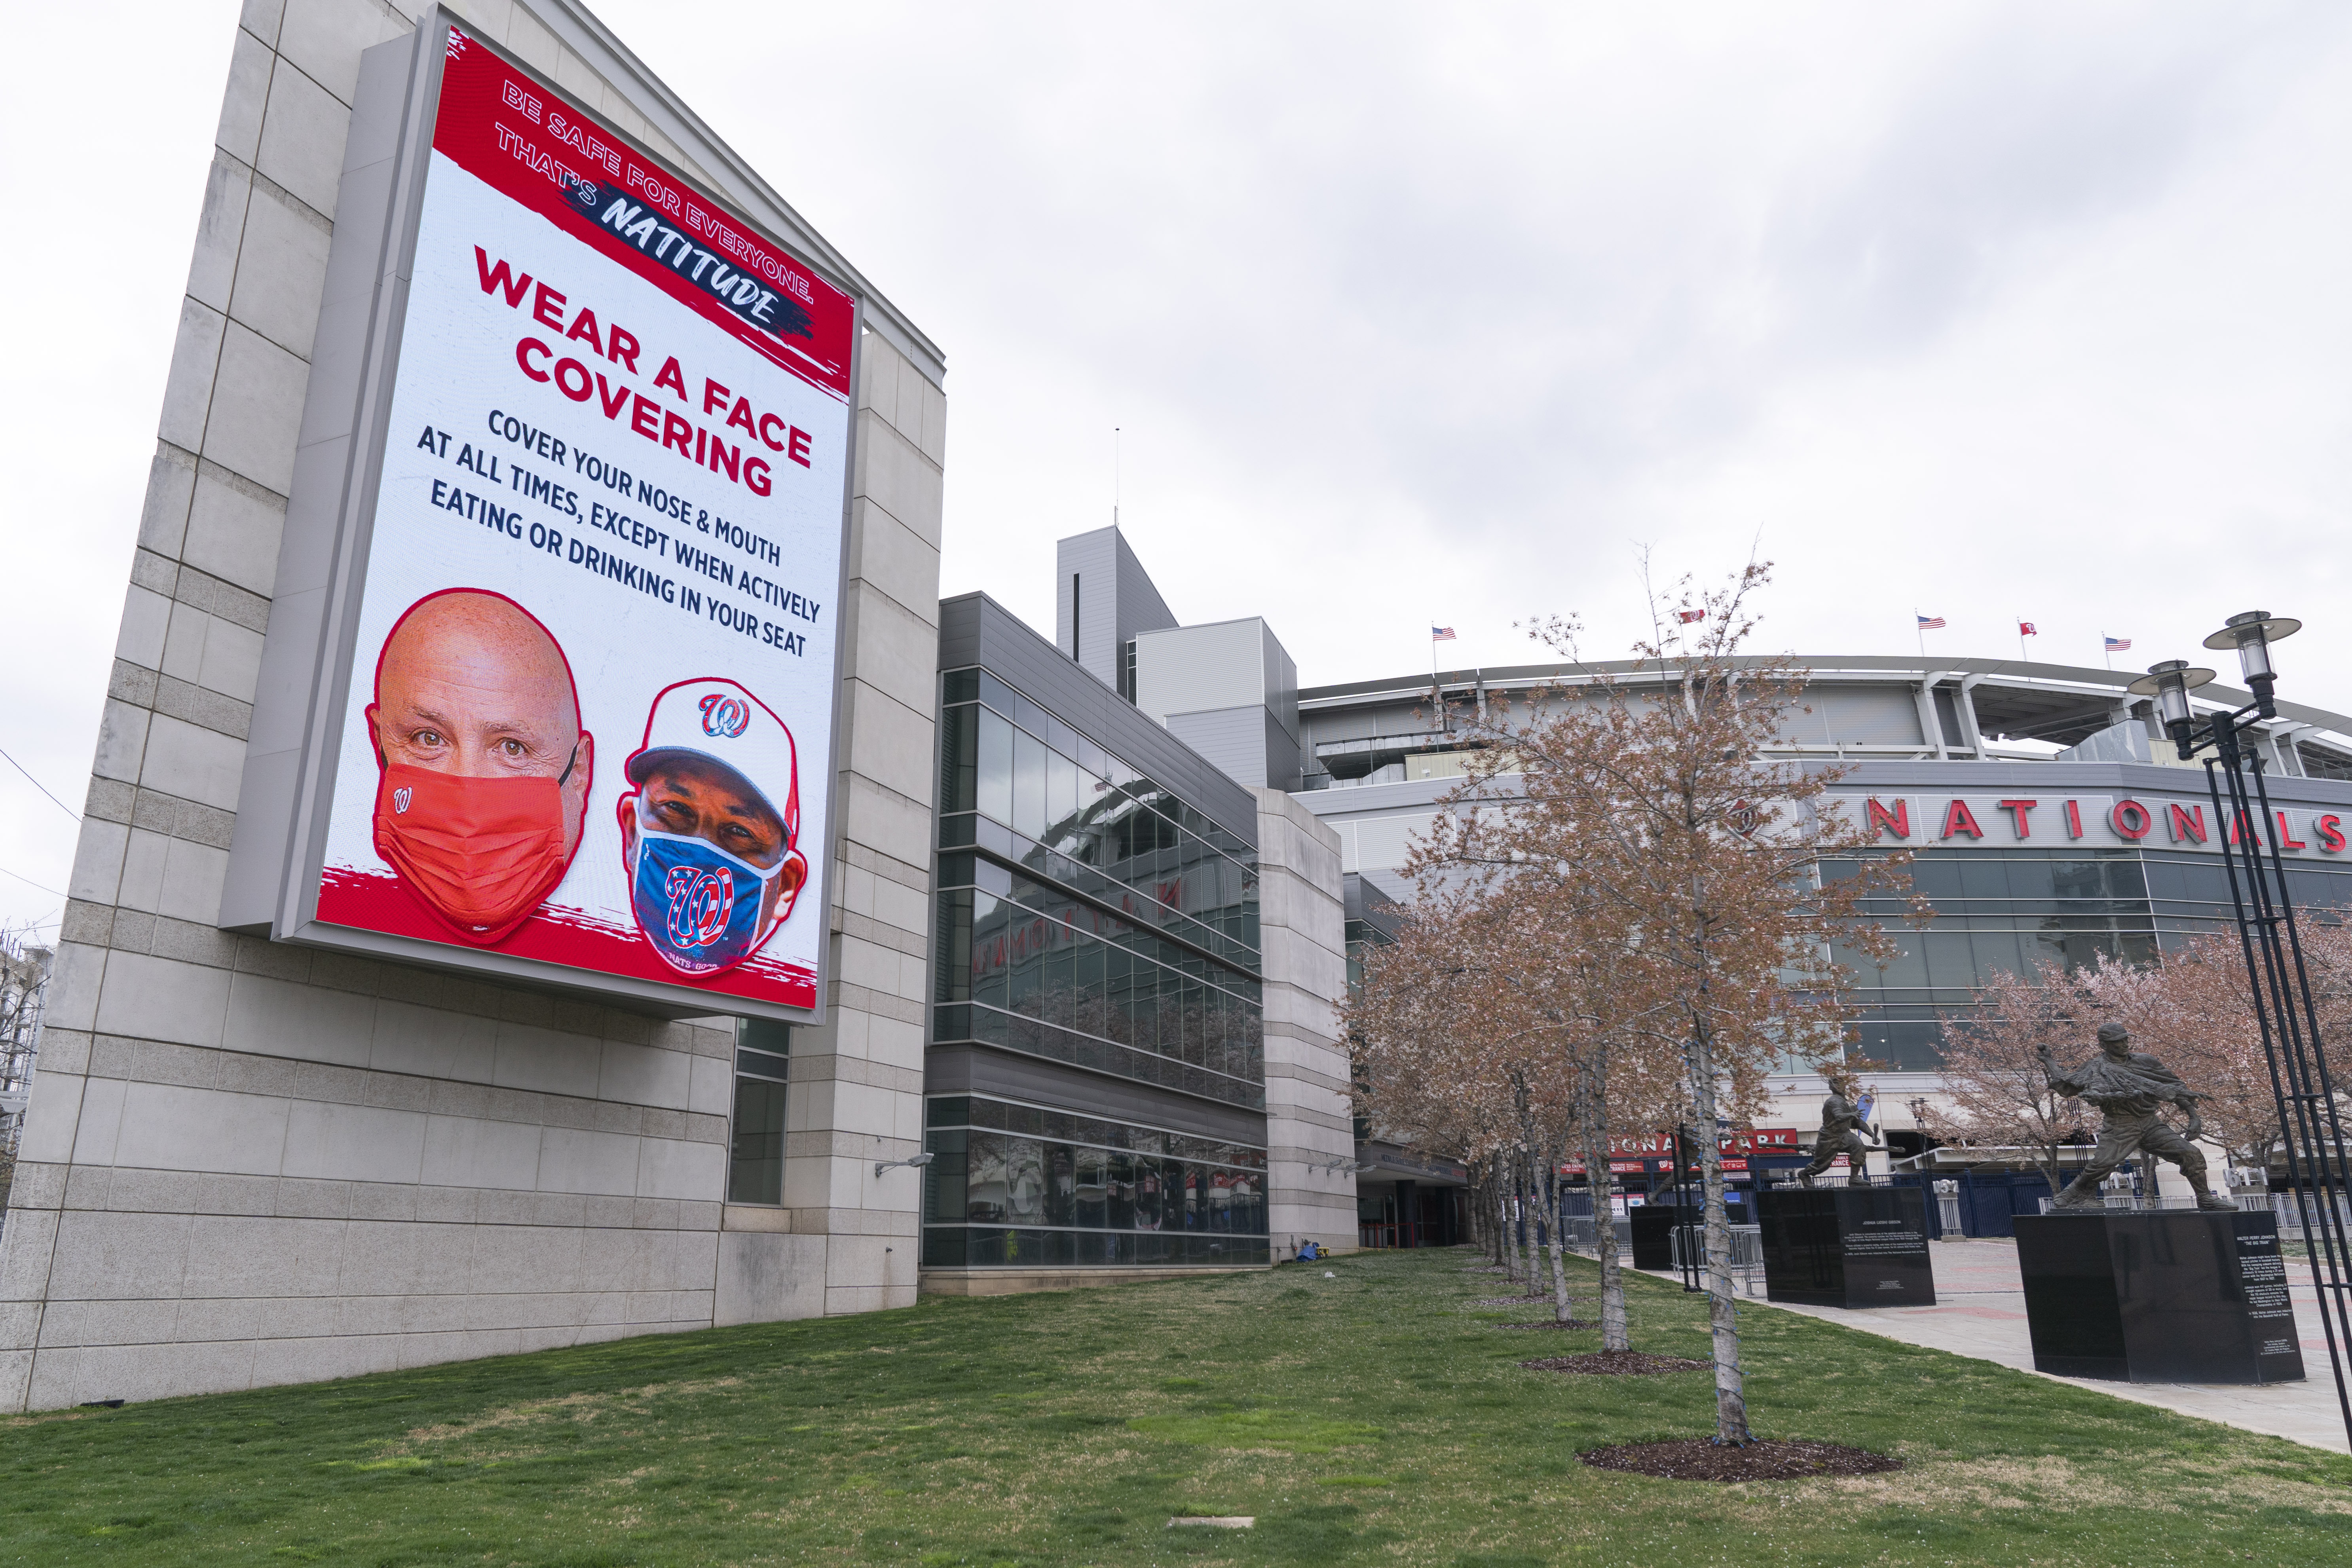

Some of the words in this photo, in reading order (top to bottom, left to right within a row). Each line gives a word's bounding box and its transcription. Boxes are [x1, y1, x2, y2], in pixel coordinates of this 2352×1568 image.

[495, 122, 598, 206] THAT'S
[602, 198, 778, 323] NATITUDE
[503, 80, 541, 125] BE
[549, 113, 620, 176] SAFE
[629, 163, 680, 218] FOR
[686, 203, 814, 304] EVERYONE.
[475, 244, 640, 375] WEAR
[653, 356, 687, 402] A
[704, 377, 812, 469] FACE
[516, 336, 771, 497] COVERING
[417, 425, 452, 459] AT
[457, 444, 502, 484] ALL
[511, 464, 583, 524] TIMES,
[591, 502, 669, 557] EXCEPT
[675, 539, 733, 587] WHEN
[738, 571, 820, 623] ACTIVELY
[431, 479, 522, 540] EATING
[530, 523, 562, 557] OR
[569, 537, 674, 604] DRINKING
[681, 586, 700, 616] IN
[707, 595, 758, 637] YOUR
[763, 623, 805, 658] SEAT
[488, 410, 566, 465] COVER
[573, 447, 632, 497] YOUR
[639, 480, 691, 525] NOSE
[697, 509, 710, 533] &
[716, 516, 780, 567] MOUTH
[1865, 798, 2346, 853] NATIONALS
[669, 952, 691, 968] NATS
[1721, 1134, 1788, 1150] PARK
